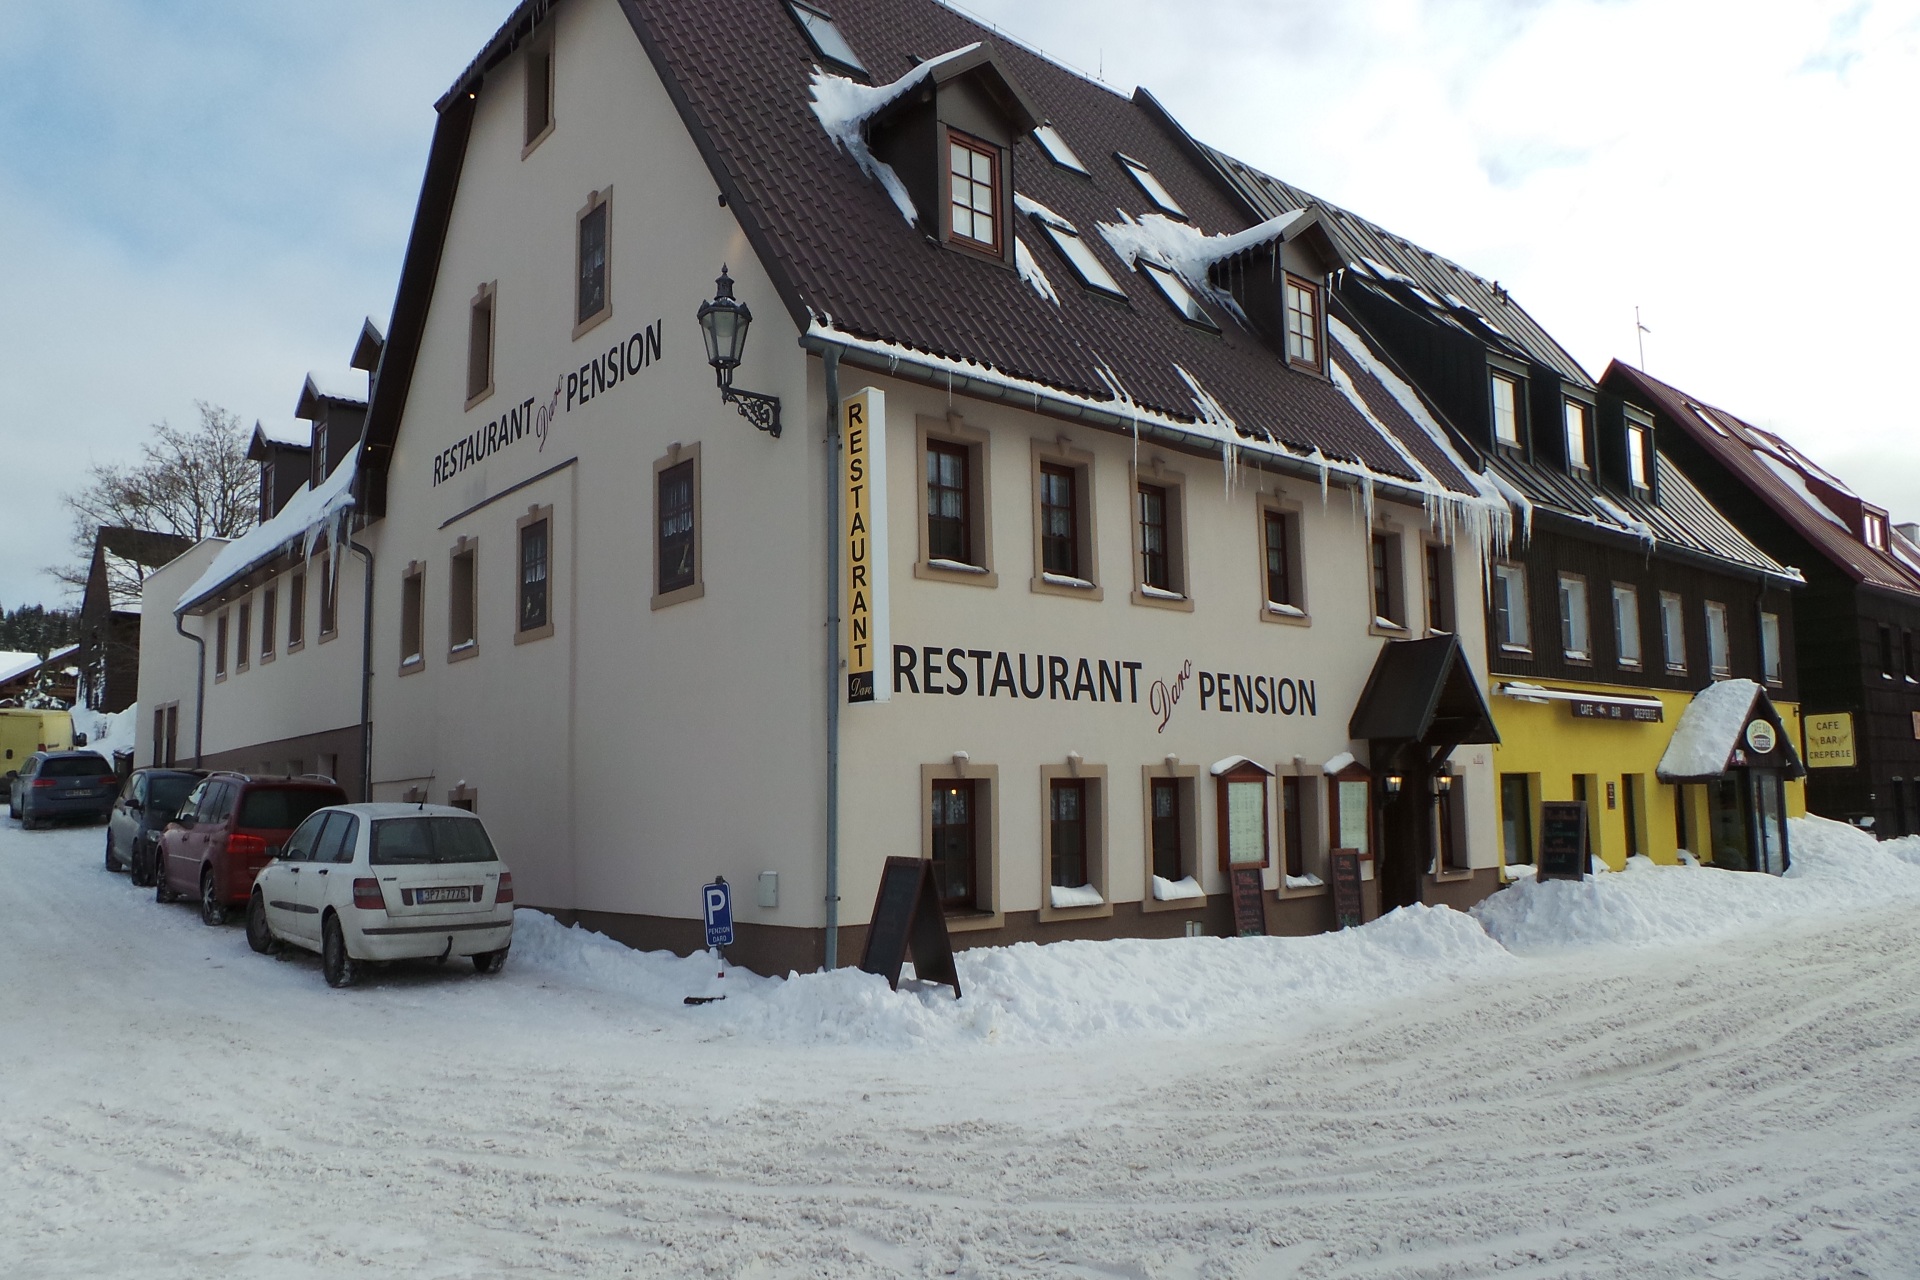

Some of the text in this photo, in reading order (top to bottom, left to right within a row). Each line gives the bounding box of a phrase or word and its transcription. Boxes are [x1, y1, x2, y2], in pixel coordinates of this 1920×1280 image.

[433, 319, 662, 488] RESTAURANT Daro PENSION
[848, 402, 868, 668] RESTAURANT
[851, 677, 872, 697] Daro
[893, 644, 1317, 734] RESTAURANT Daro PENSION
[1580, 703, 1594, 716] CAFE
[1611, 706, 1621, 717] BAR
[1816, 721, 1839, 731] CAFE
[1820, 736, 1838, 745] BAR
[1809, 750, 1851, 759] CREPERIE
[706, 889, 726, 925] P
[708, 926, 731, 935] PENZION
[712, 935, 727, 943] DARO
